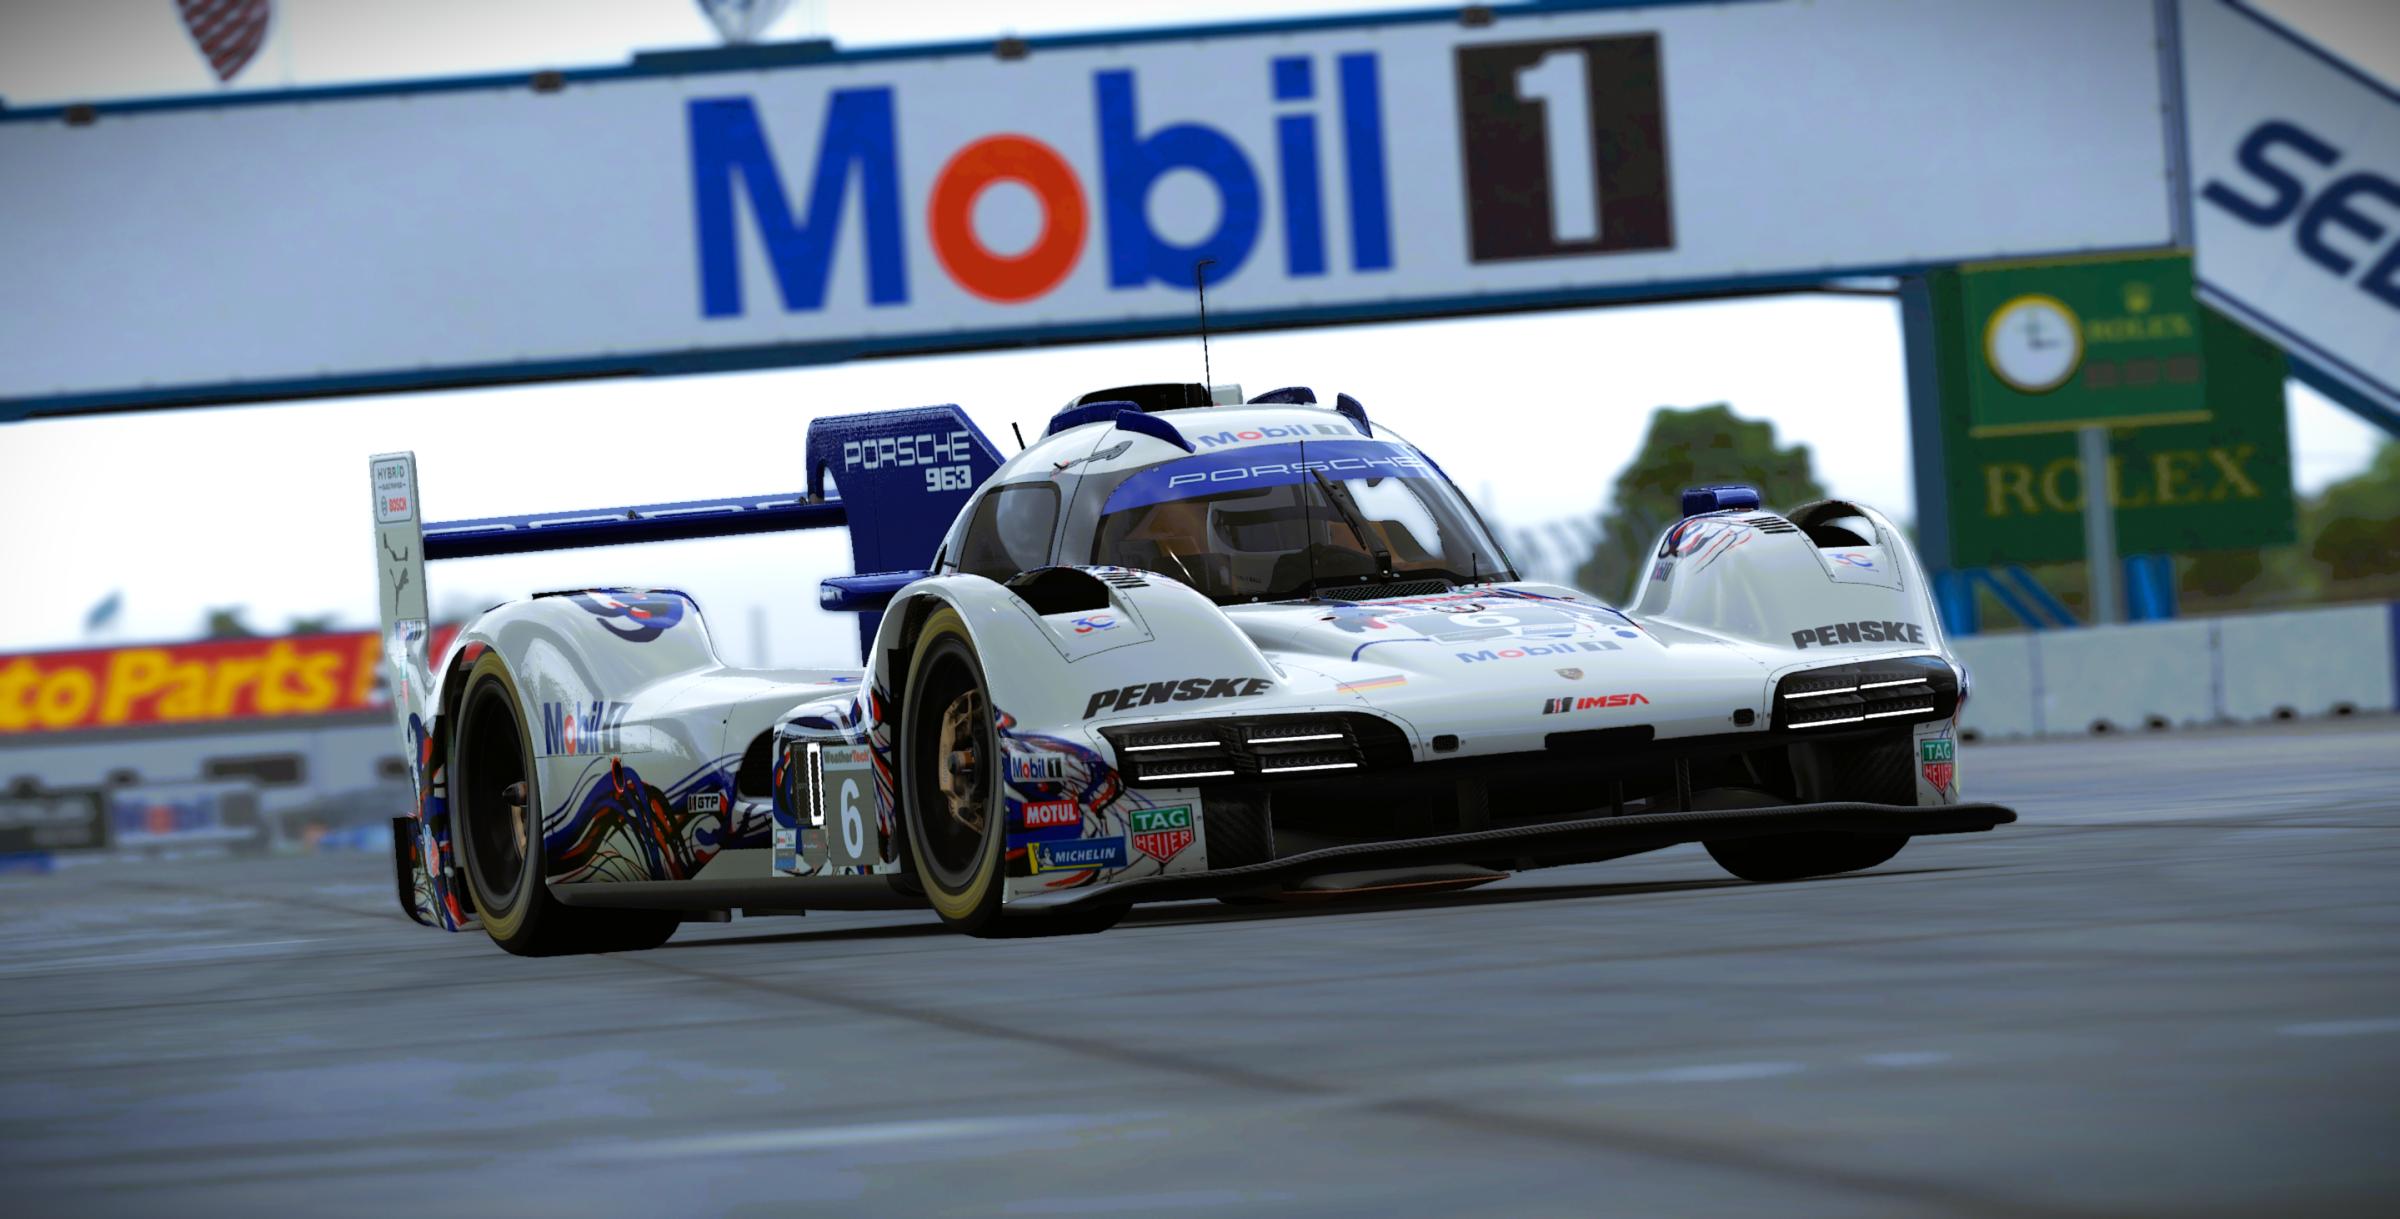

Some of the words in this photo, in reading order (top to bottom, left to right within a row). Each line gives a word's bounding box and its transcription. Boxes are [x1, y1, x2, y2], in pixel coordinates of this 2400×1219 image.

[686, 51, 1394, 320] Mobil
[1518, 50, 1600, 246] 1
[1198, 424, 1311, 447] Mobil
[844, 431, 971, 472] PORSCHE
[925, 465, 972, 492] 963
[1168, 456, 1426, 489] PORSCHE
[1448, 612, 1520, 628] 6
[1791, 621, 1926, 650] PENSKE
[1455, 643, 1577, 663] Mobil
[100, 641, 342, 726] Parts
[1083, 678, 1274, 720] PENSKE
[1576, 693, 1650, 710] IMSA
[544, 701, 604, 757] Mobil
[1012, 757, 1046, 778] Mobil
[697, 795, 719, 809] GTP
[1026, 803, 1076, 824] MOTUL
[840, 778, 863, 859] 6
[1136, 809, 1187, 830] TAG
[1055, 847, 1116, 862] MICHELIN
[1135, 830, 1190, 860] HEUER
